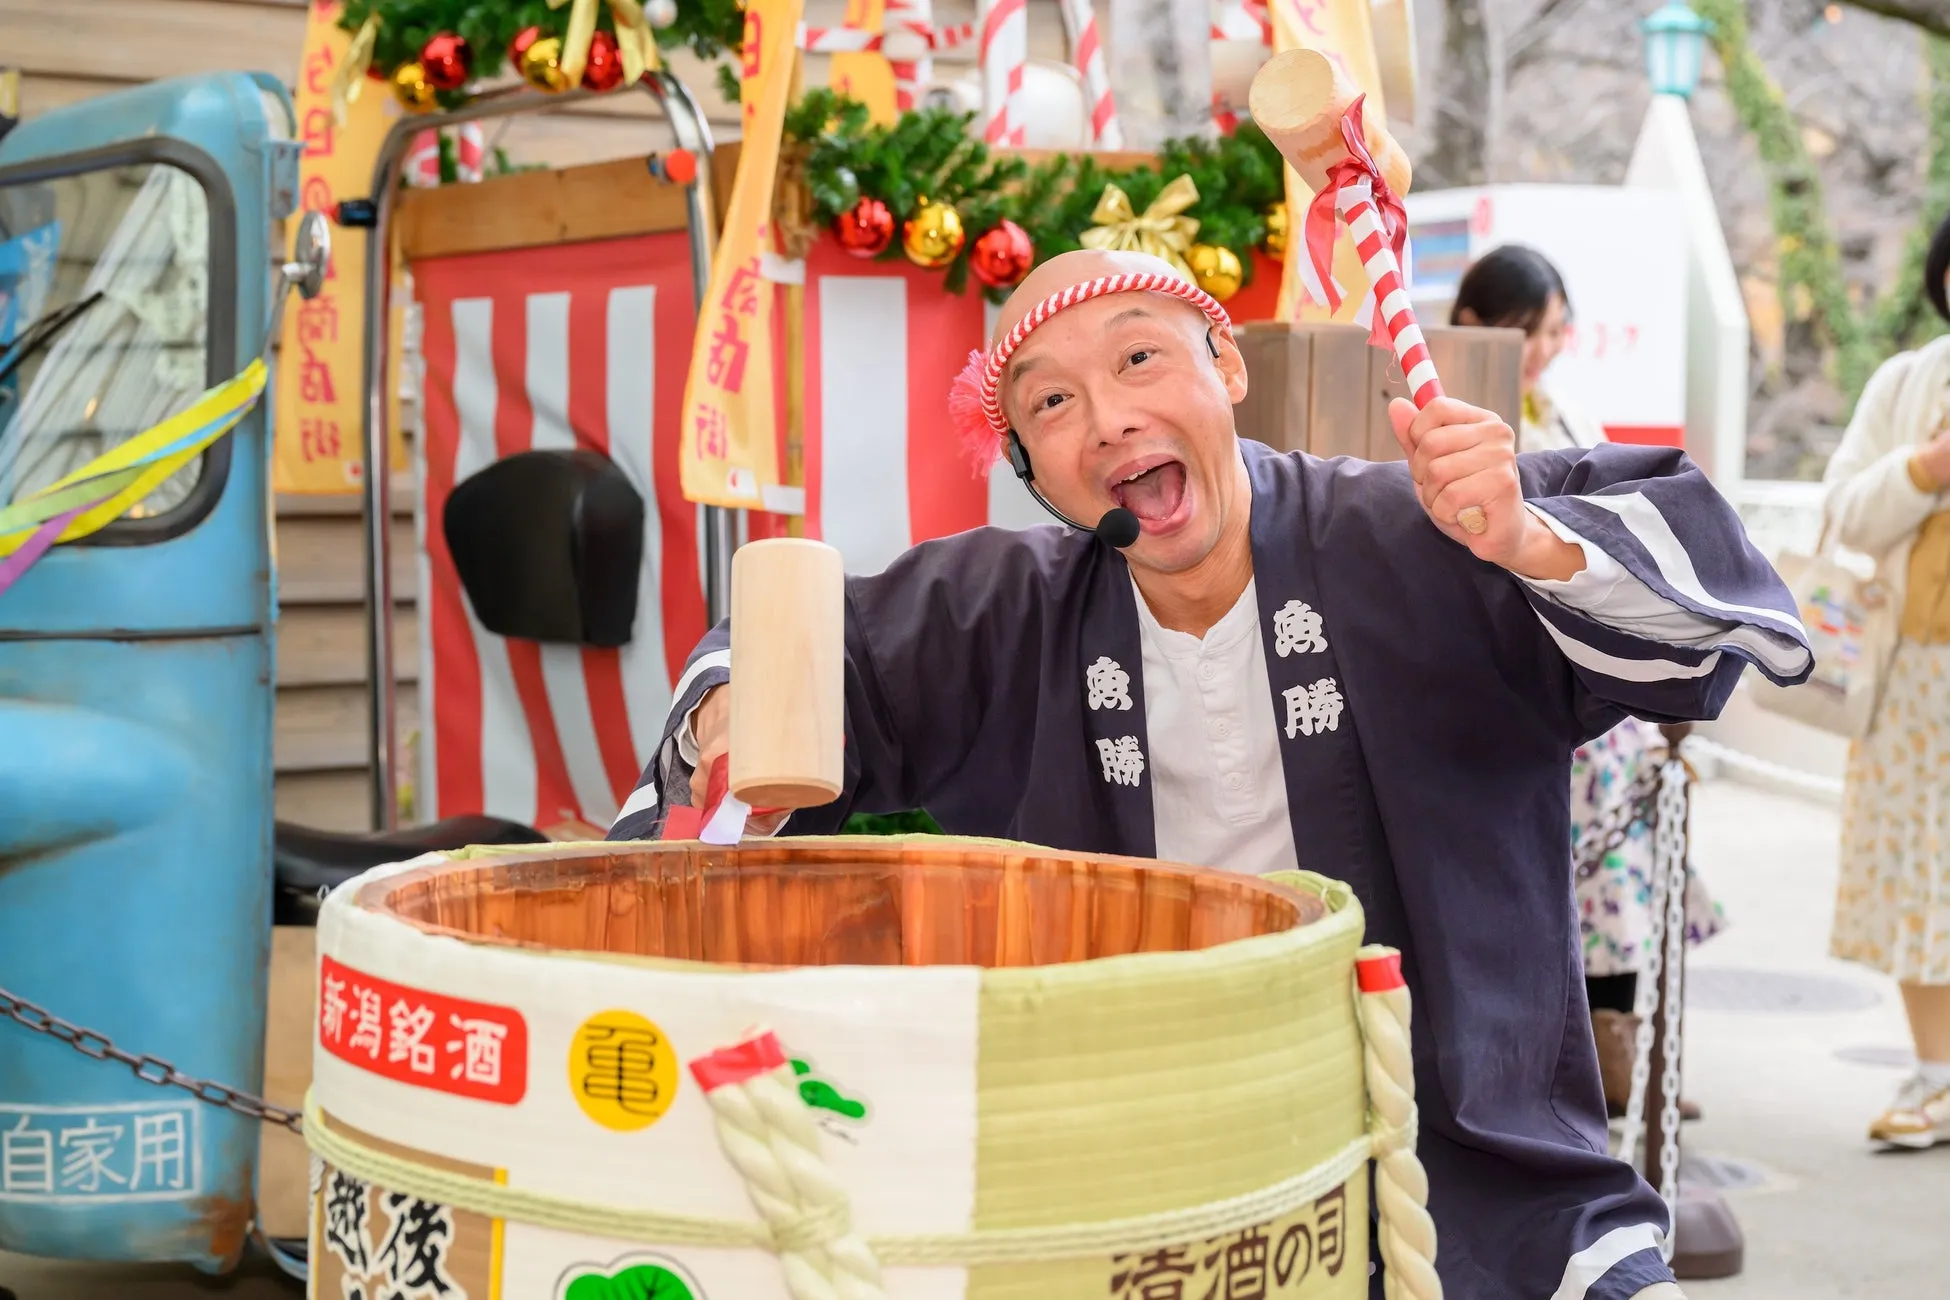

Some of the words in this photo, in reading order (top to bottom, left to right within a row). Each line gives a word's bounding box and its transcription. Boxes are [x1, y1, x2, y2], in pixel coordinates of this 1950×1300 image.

[1086, 655, 1145, 788] 魚勝
[1273, 599, 1344, 739] 魚勝
[322, 971, 508, 1086] 新潟銘酒
[3, 1114, 185, 1193] 自家用
